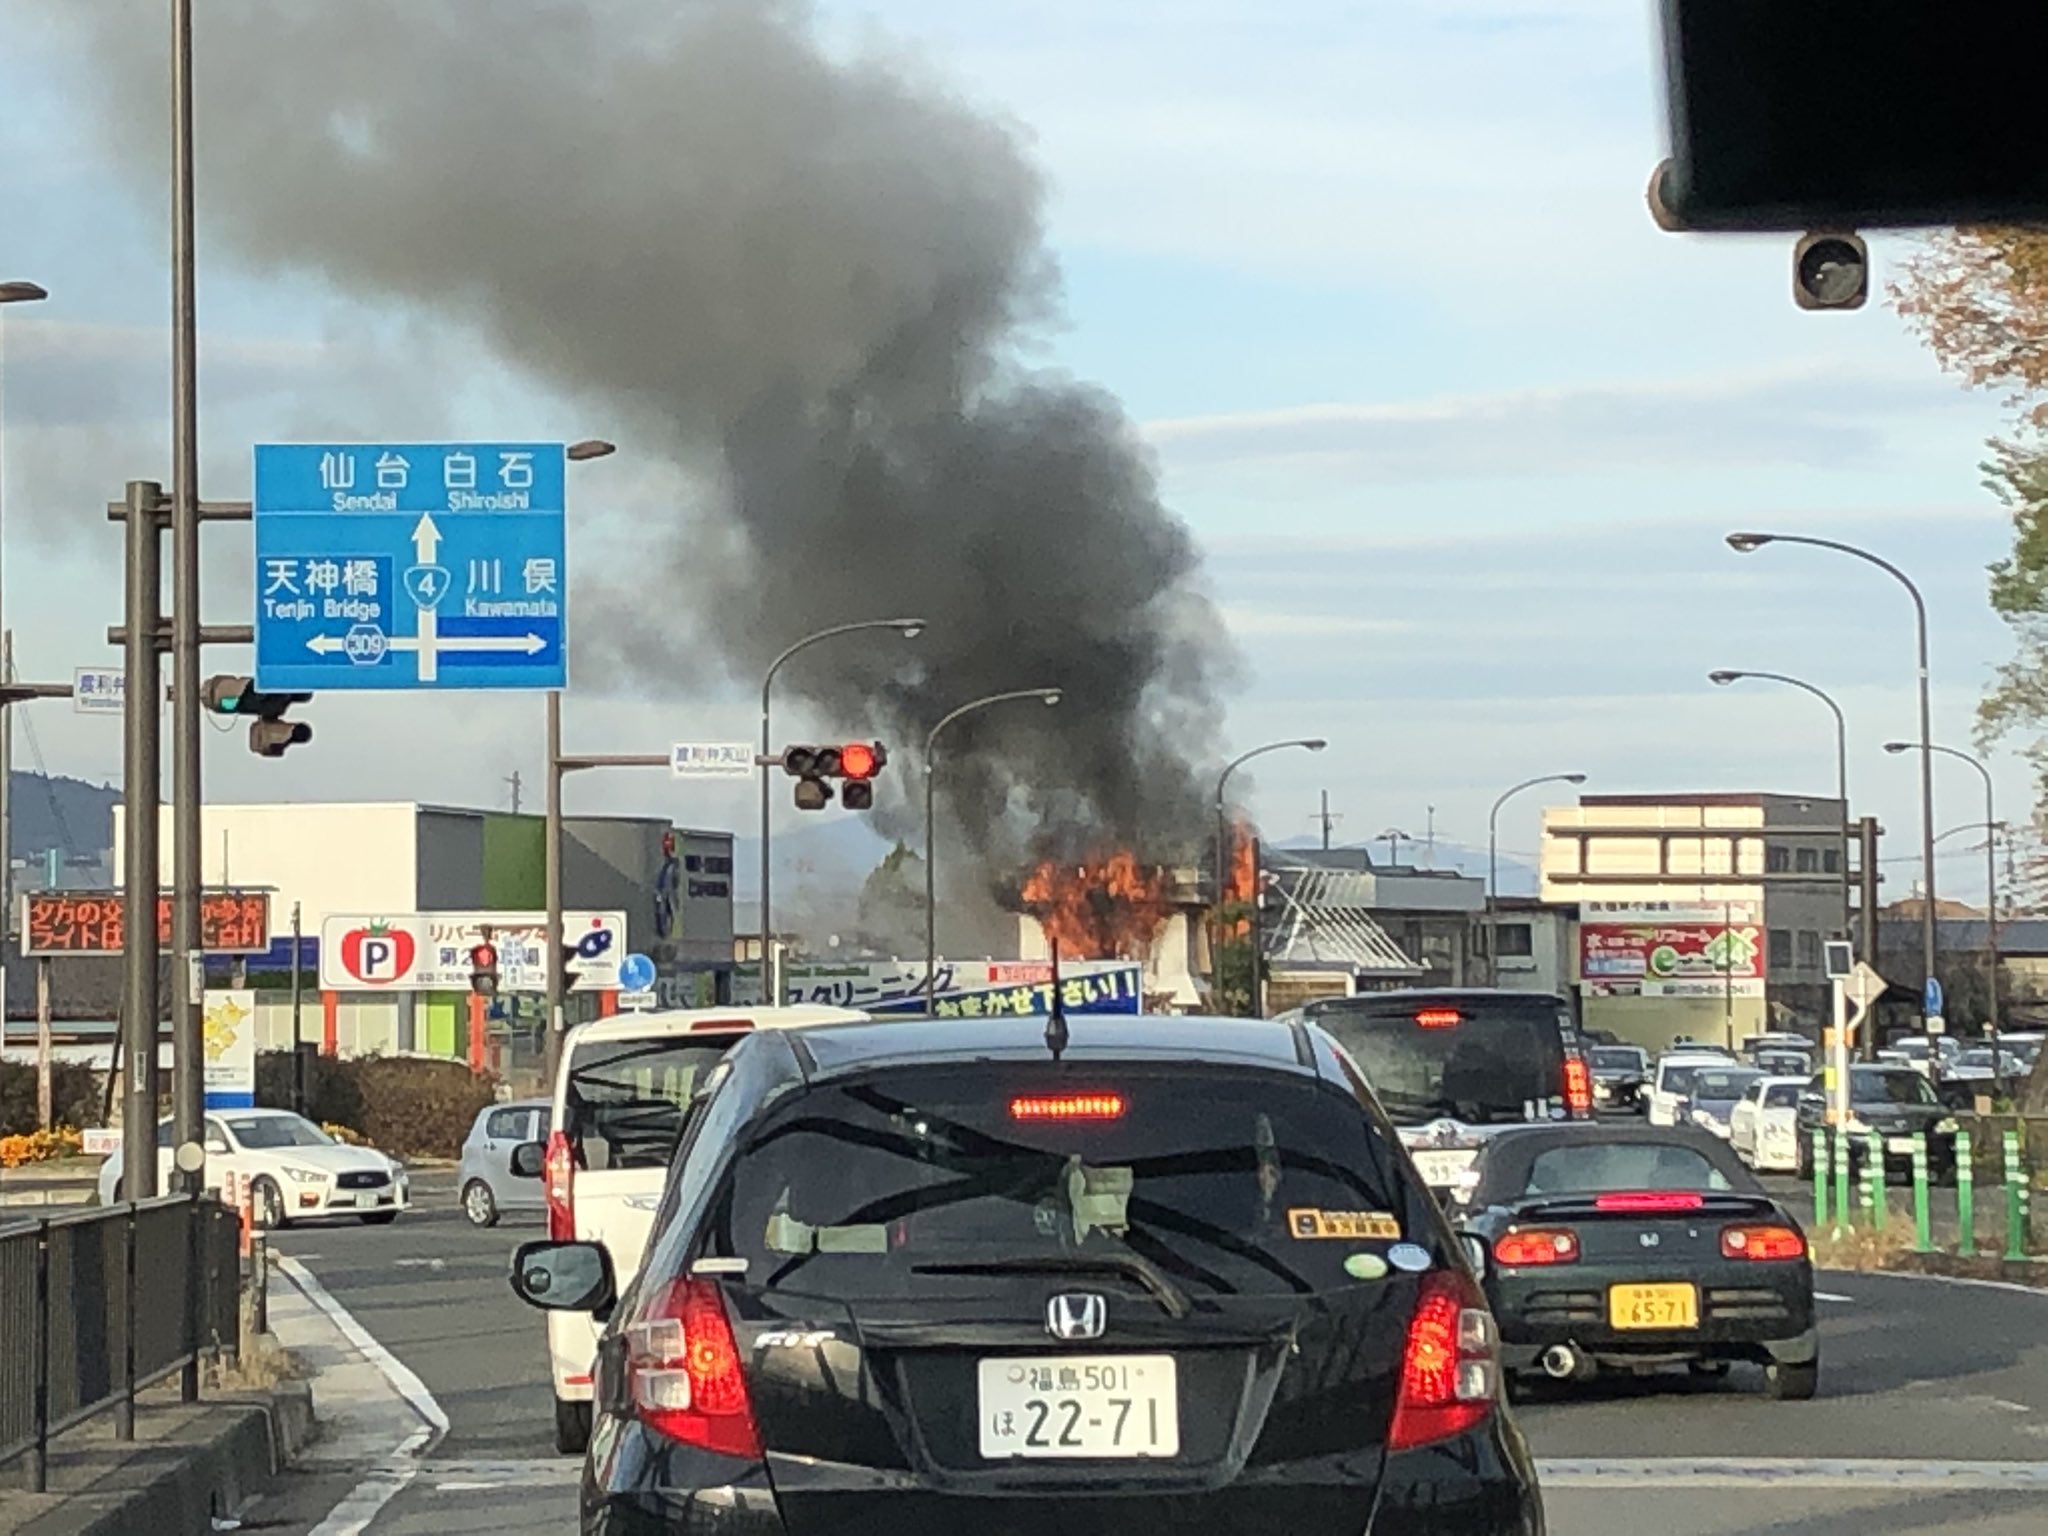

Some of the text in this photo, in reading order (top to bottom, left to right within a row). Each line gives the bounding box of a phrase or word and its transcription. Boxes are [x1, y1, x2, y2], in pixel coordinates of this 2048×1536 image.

[320, 452, 534, 489] 仙台 白石
[333, 491, 529, 511] Sendai Shiroishi
[264, 560, 378, 596] 天神橋
[417, 573, 437, 597] 4
[467, 558, 557, 594] 川俣
[264, 599, 380, 621] Tenjin Bridge
[465, 599, 557, 617] Kawamata
[350, 637, 381, 652] 309
[365, 941, 389, 974] P
[992, 1398, 1158, 1447] ほ 22-71
